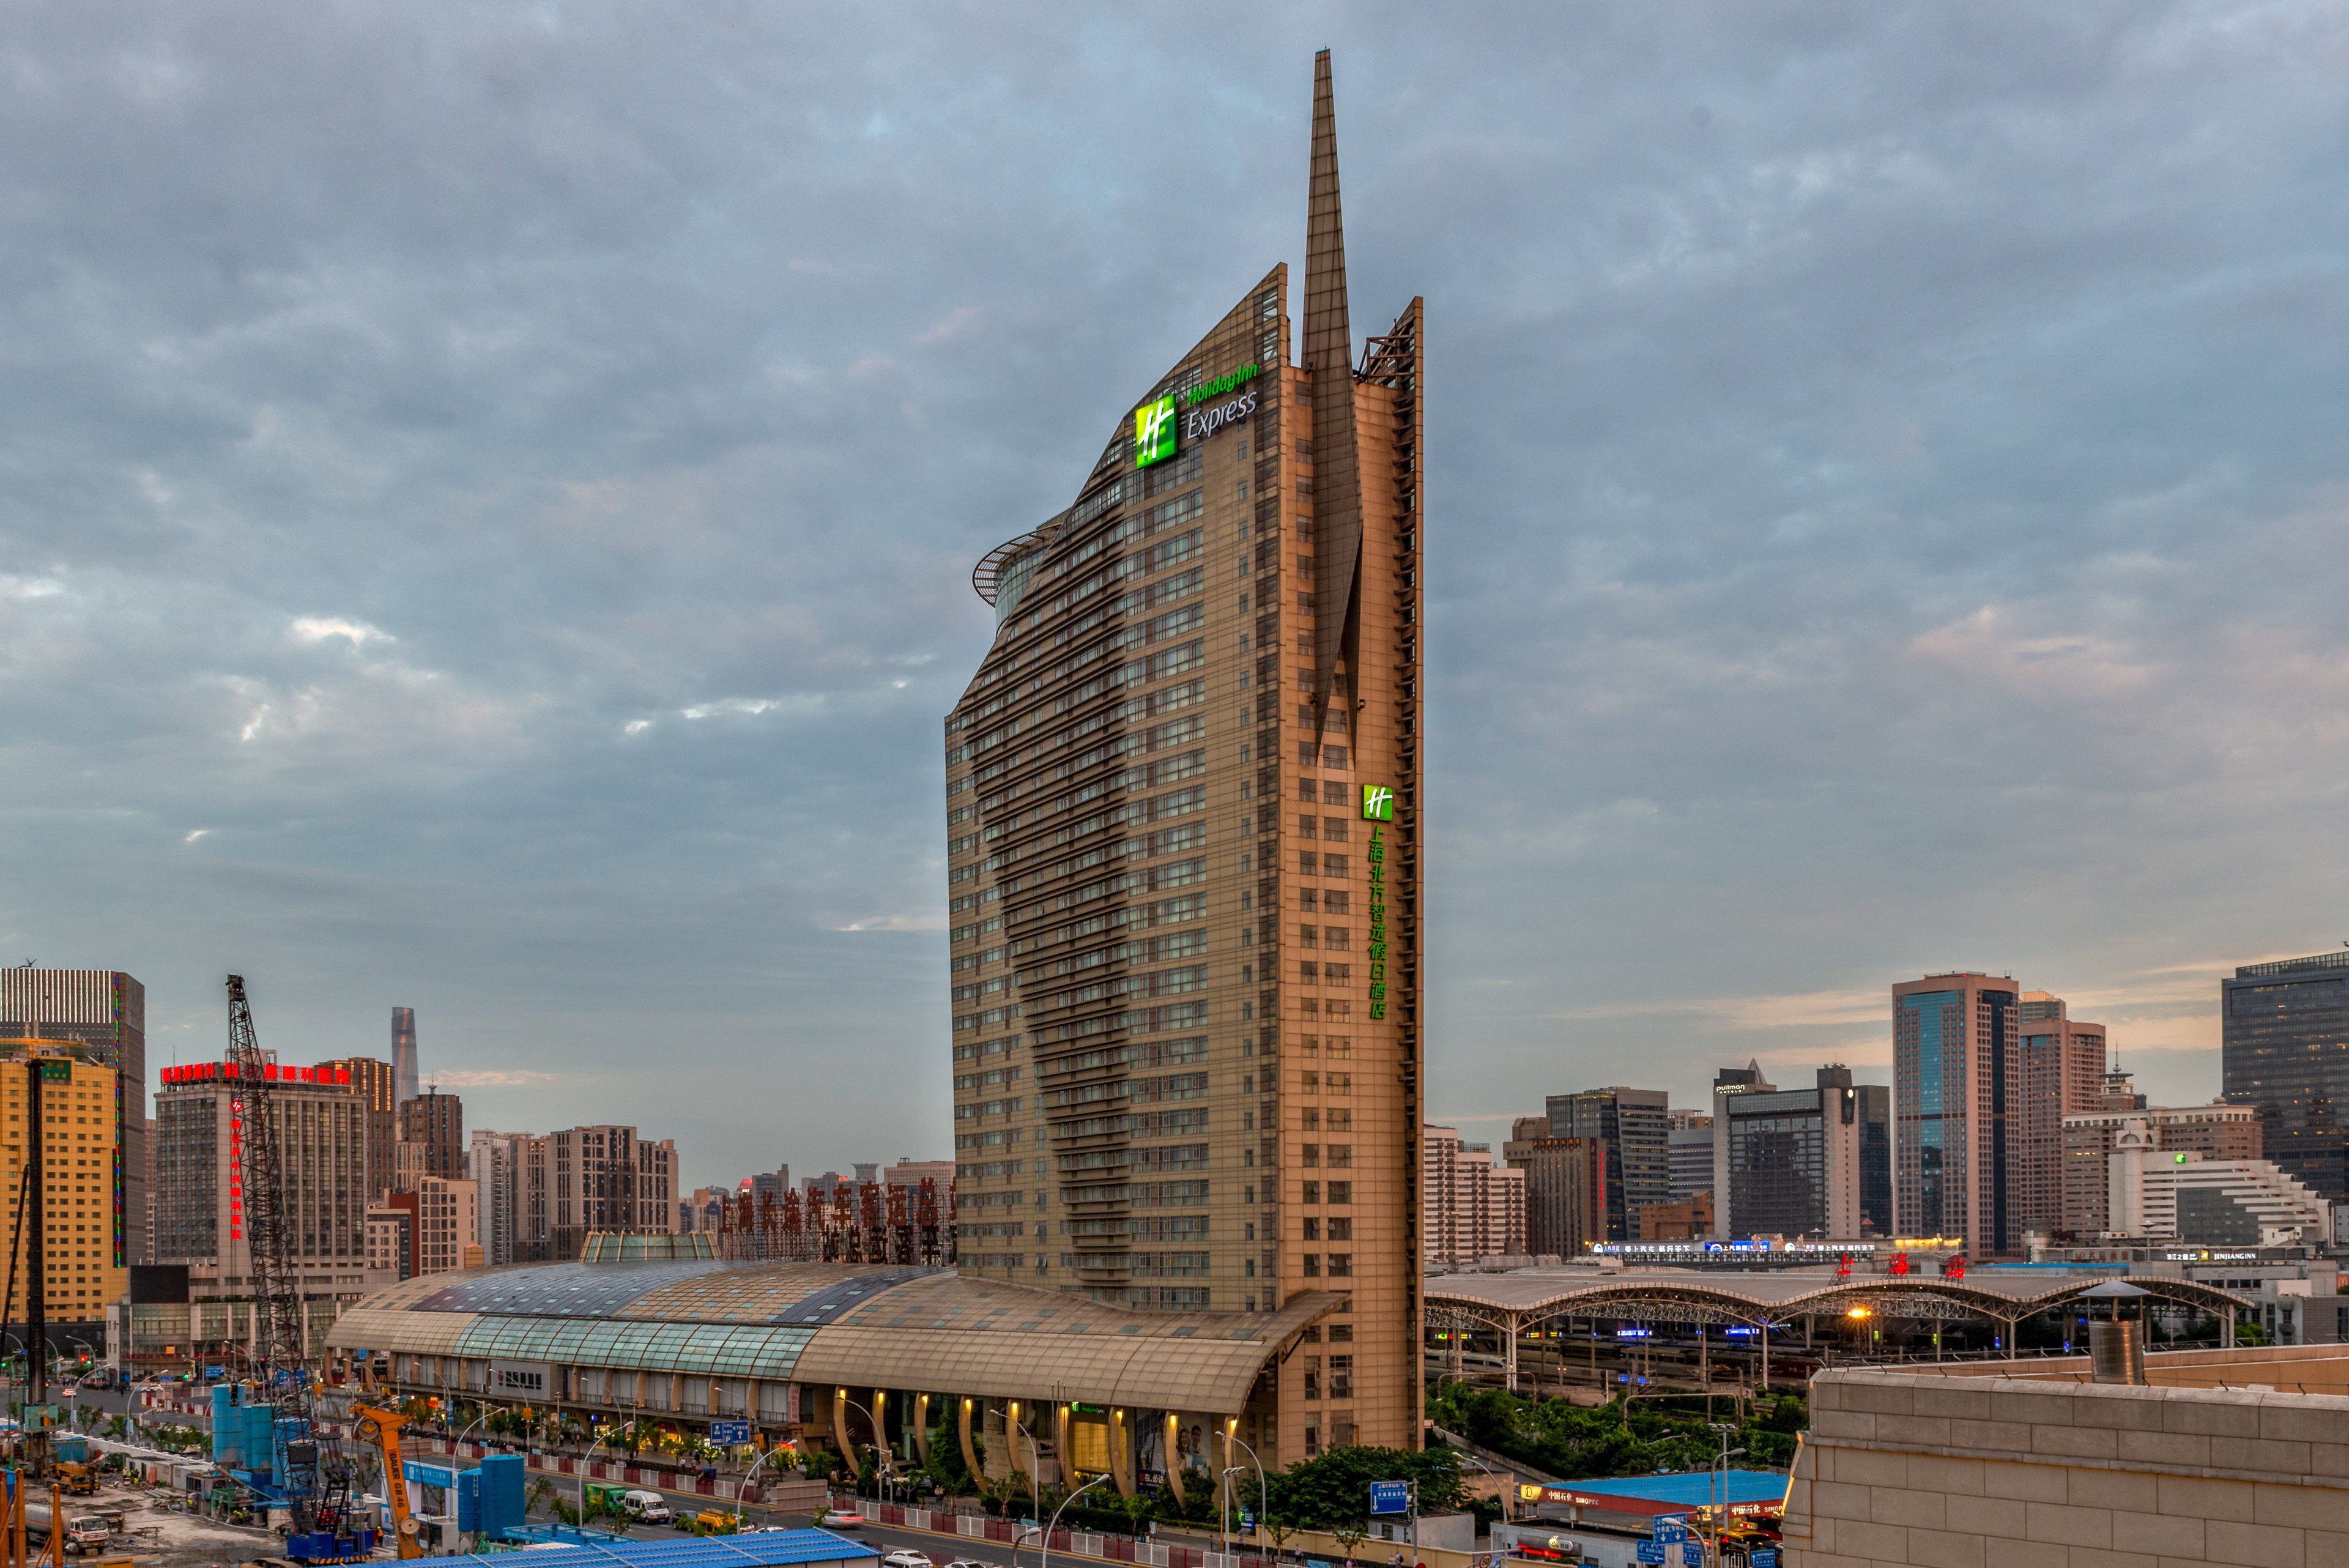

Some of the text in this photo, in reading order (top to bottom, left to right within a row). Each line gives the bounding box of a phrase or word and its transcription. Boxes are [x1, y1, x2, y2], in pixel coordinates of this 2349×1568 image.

[1188, 363, 1258, 406] Holiday Inn
[1187, 391, 1258, 439] Express
[1369, 825, 1387, 1020] 上海北方智选假日酒店
[1716, 1084, 1745, 1093] pullman
[1837, 1251, 1967, 1279] 上海站
[389, 1453, 400, 1480] BAUER
[1548, 1490, 1573, 1502] 中国石化
[1575, 1497, 1600, 1506] SINOPEC
